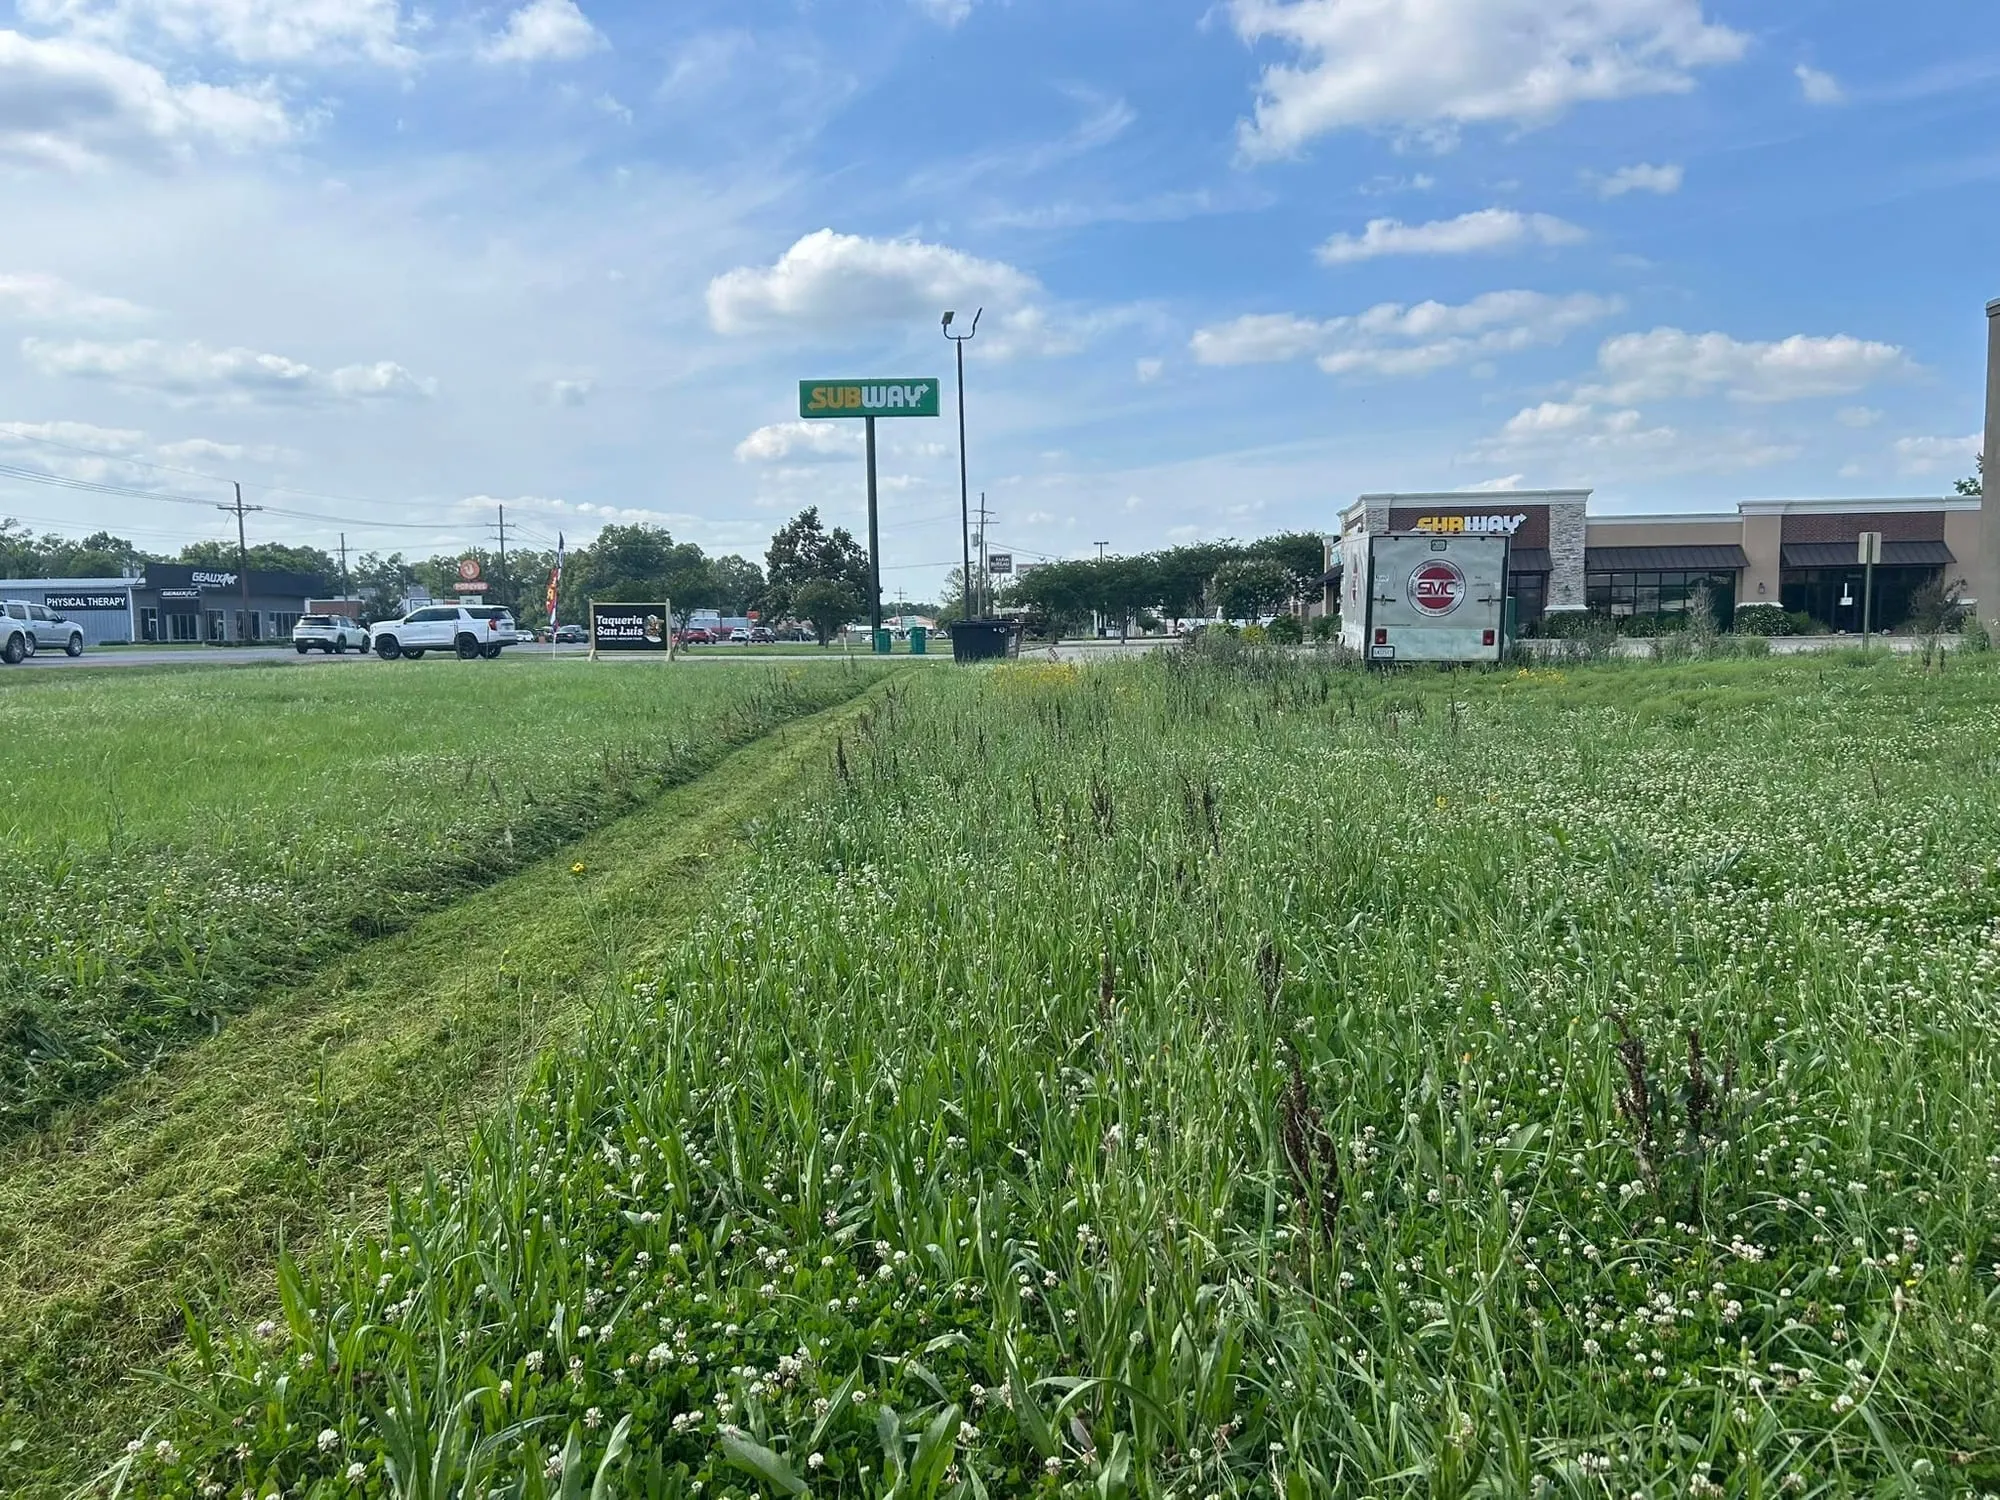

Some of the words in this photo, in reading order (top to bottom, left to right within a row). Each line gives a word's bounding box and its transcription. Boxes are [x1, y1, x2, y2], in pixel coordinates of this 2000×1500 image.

[808, 383, 930, 410] SUBWAY
[1409, 513, 1527, 534] SUBWAY
[1417, 581, 1456, 595] SMC
[46, 597, 87, 607] PHYSICAL
[87, 597, 126, 606] THERAPY
[595, 615, 643, 627] Taqueria
[596, 626, 618, 636] San
[619, 626, 644, 636] Luis
